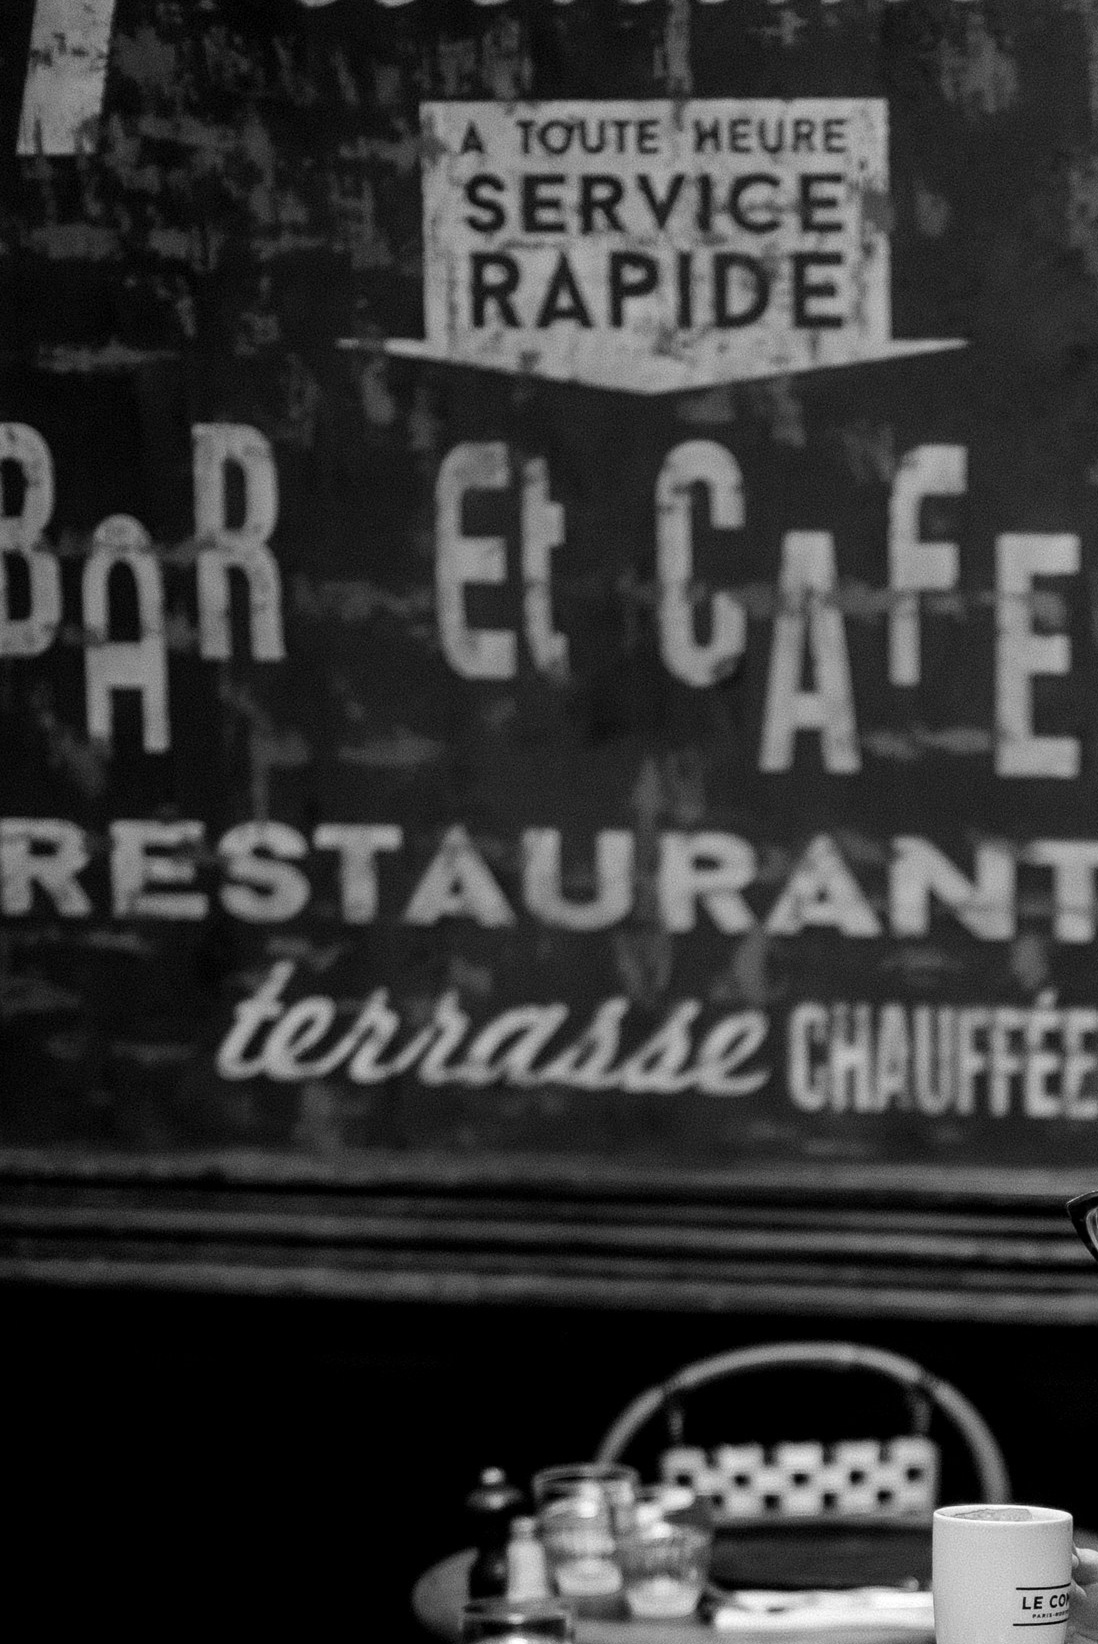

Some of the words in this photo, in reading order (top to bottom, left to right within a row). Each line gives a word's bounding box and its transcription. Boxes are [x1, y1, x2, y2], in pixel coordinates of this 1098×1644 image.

[459, 121, 486, 154] A
[515, 118, 661, 155] TOUTE
[696, 117, 848, 154] HEURE
[463, 172, 846, 235] SERVICE
[470, 250, 846, 330] RAPIDE
[215, 960, 771, 1096] terrasse
[1022, 1595, 1044, 1610] LE
